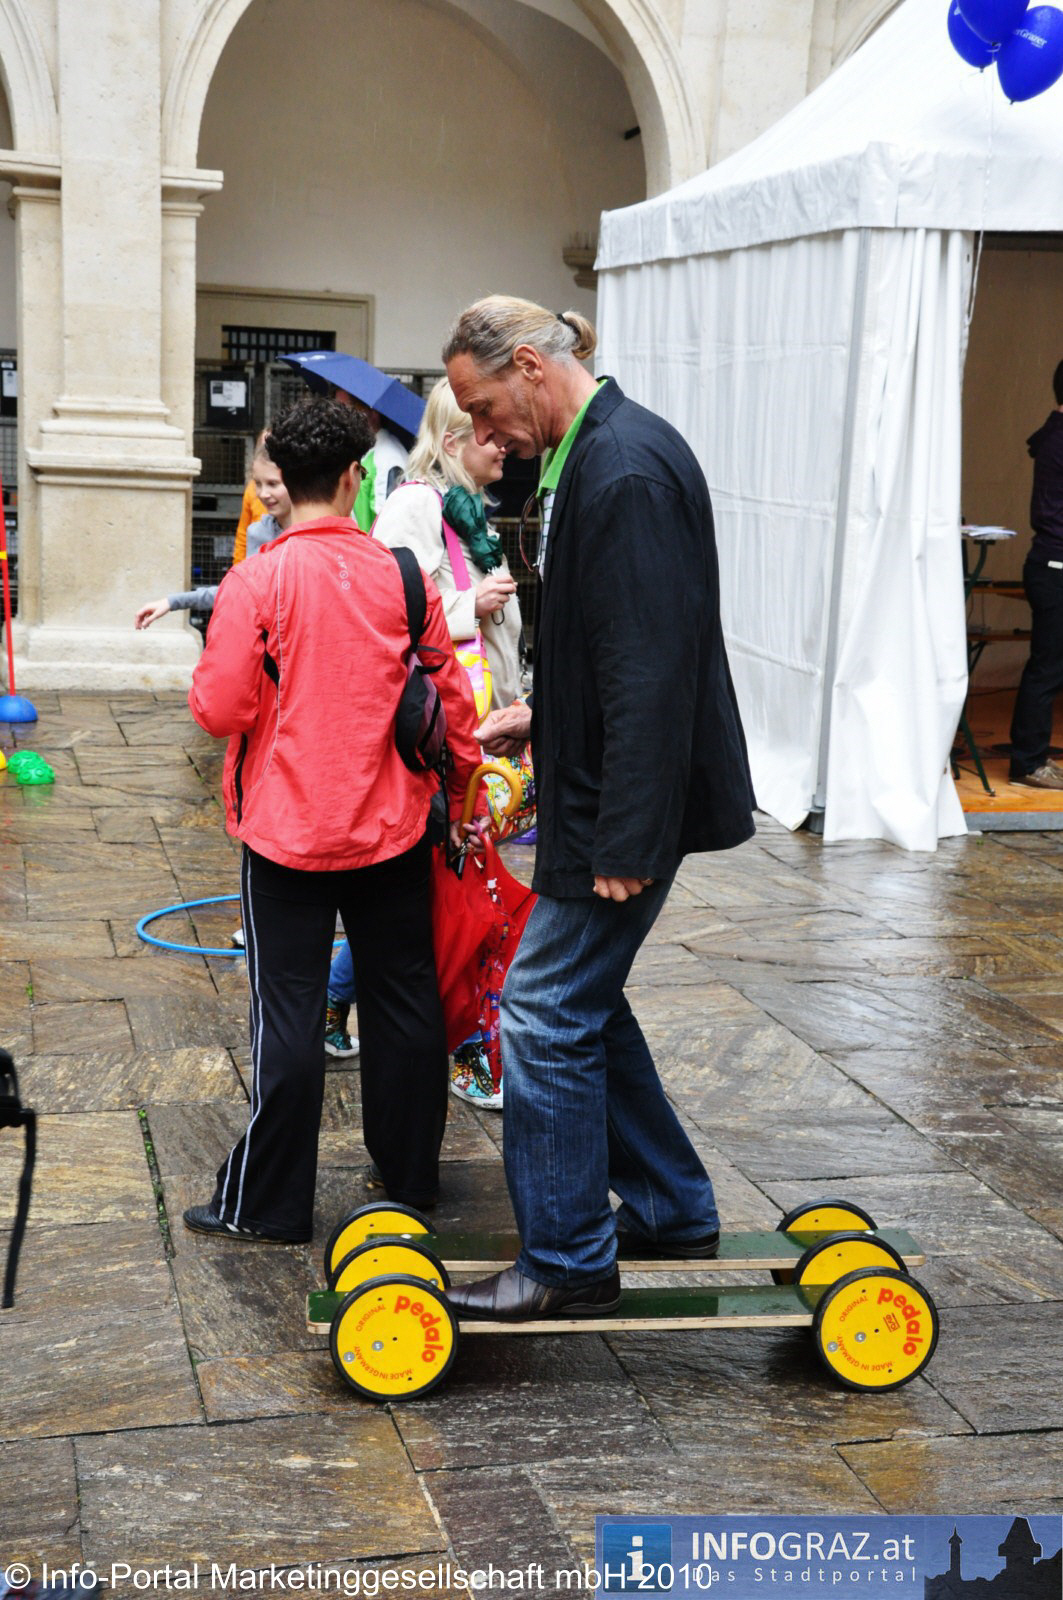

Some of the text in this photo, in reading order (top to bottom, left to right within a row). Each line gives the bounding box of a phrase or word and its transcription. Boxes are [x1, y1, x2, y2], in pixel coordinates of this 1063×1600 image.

[355, 1304, 386, 1332] ORIGINAL
[839, 1295, 869, 1322] ORIGINAL
[877, 1287, 924, 1356] pedalo
[394, 1295, 444, 1363] pedalo
[354, 1346, 413, 1380] MADE IN GERMANY
[837, 1335, 893, 1371] MADE IN GERMANY
